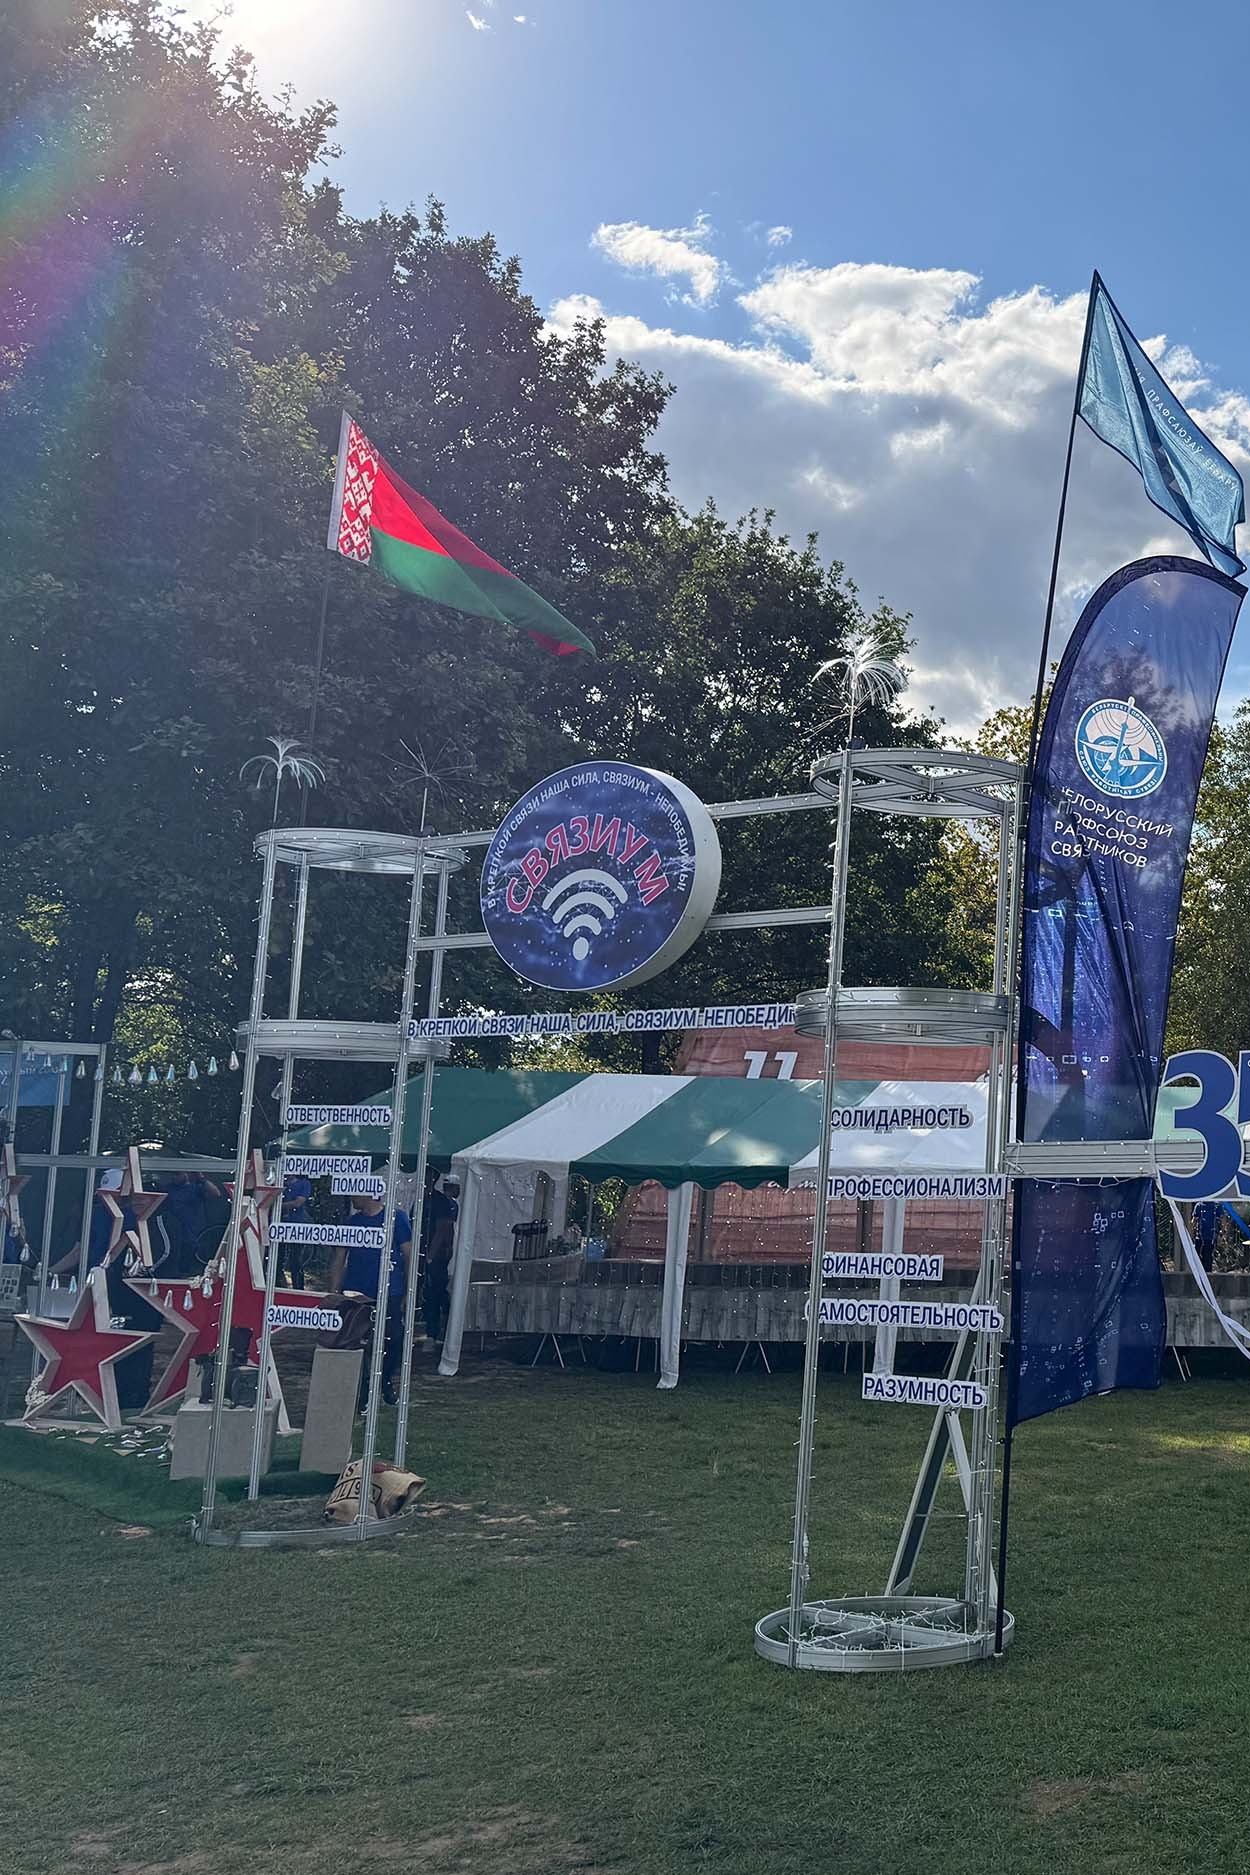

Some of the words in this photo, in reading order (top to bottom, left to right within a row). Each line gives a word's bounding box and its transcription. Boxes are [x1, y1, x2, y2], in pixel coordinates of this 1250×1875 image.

[1203, 459, 1240, 495] БЕЛАРУС
[487, 829, 512, 895] КРЕПКОЙ
[510, 796, 540, 831] СВЯЗИ
[540, 780, 570, 802] НАША
[571, 771, 601, 787] СИЛА,
[603, 771, 650, 796] СВЯЗИУМ
[1057, 800, 1148, 850] ПОФСОЮЗ
[506, 814, 669, 913] СВЯЗИУМ
[407, 1021, 416, 1037] В
[420, 1017, 477, 1036] КРЕПКОЙ
[481, 1015, 525, 1033] СВЯЗИ
[530, 1013, 571, 1032] НАША
[577, 1013, 619, 1033] СИЛА,
[625, 1008, 697, 1029] СВЯЗИУМ
[704, 1005, 796, 1028] НЕПОБЕДИ
[286, 1108, 391, 1123] ОТВЕТСТВЕННОСТЬ
[831, 1107, 971, 1130] СОЛИДАРНОСТЬ
[286, 1158, 369, 1176] ЮРИДИЧЕСКАЯ
[332, 1178, 384, 1196] ПОМОЩЬ
[269, 1225, 384, 1246] ОРГАНИЗОВАННОСТЬ
[822, 1255, 940, 1277] ФИНАНСОВАЯ
[267, 1308, 340, 1328] ЗАКОННОСТЬ
[818, 1302, 1001, 1329] АМОСТОЯТЕЛЬНОСТЬ
[864, 1377, 983, 1406] РАЗУМНОСТЬ
